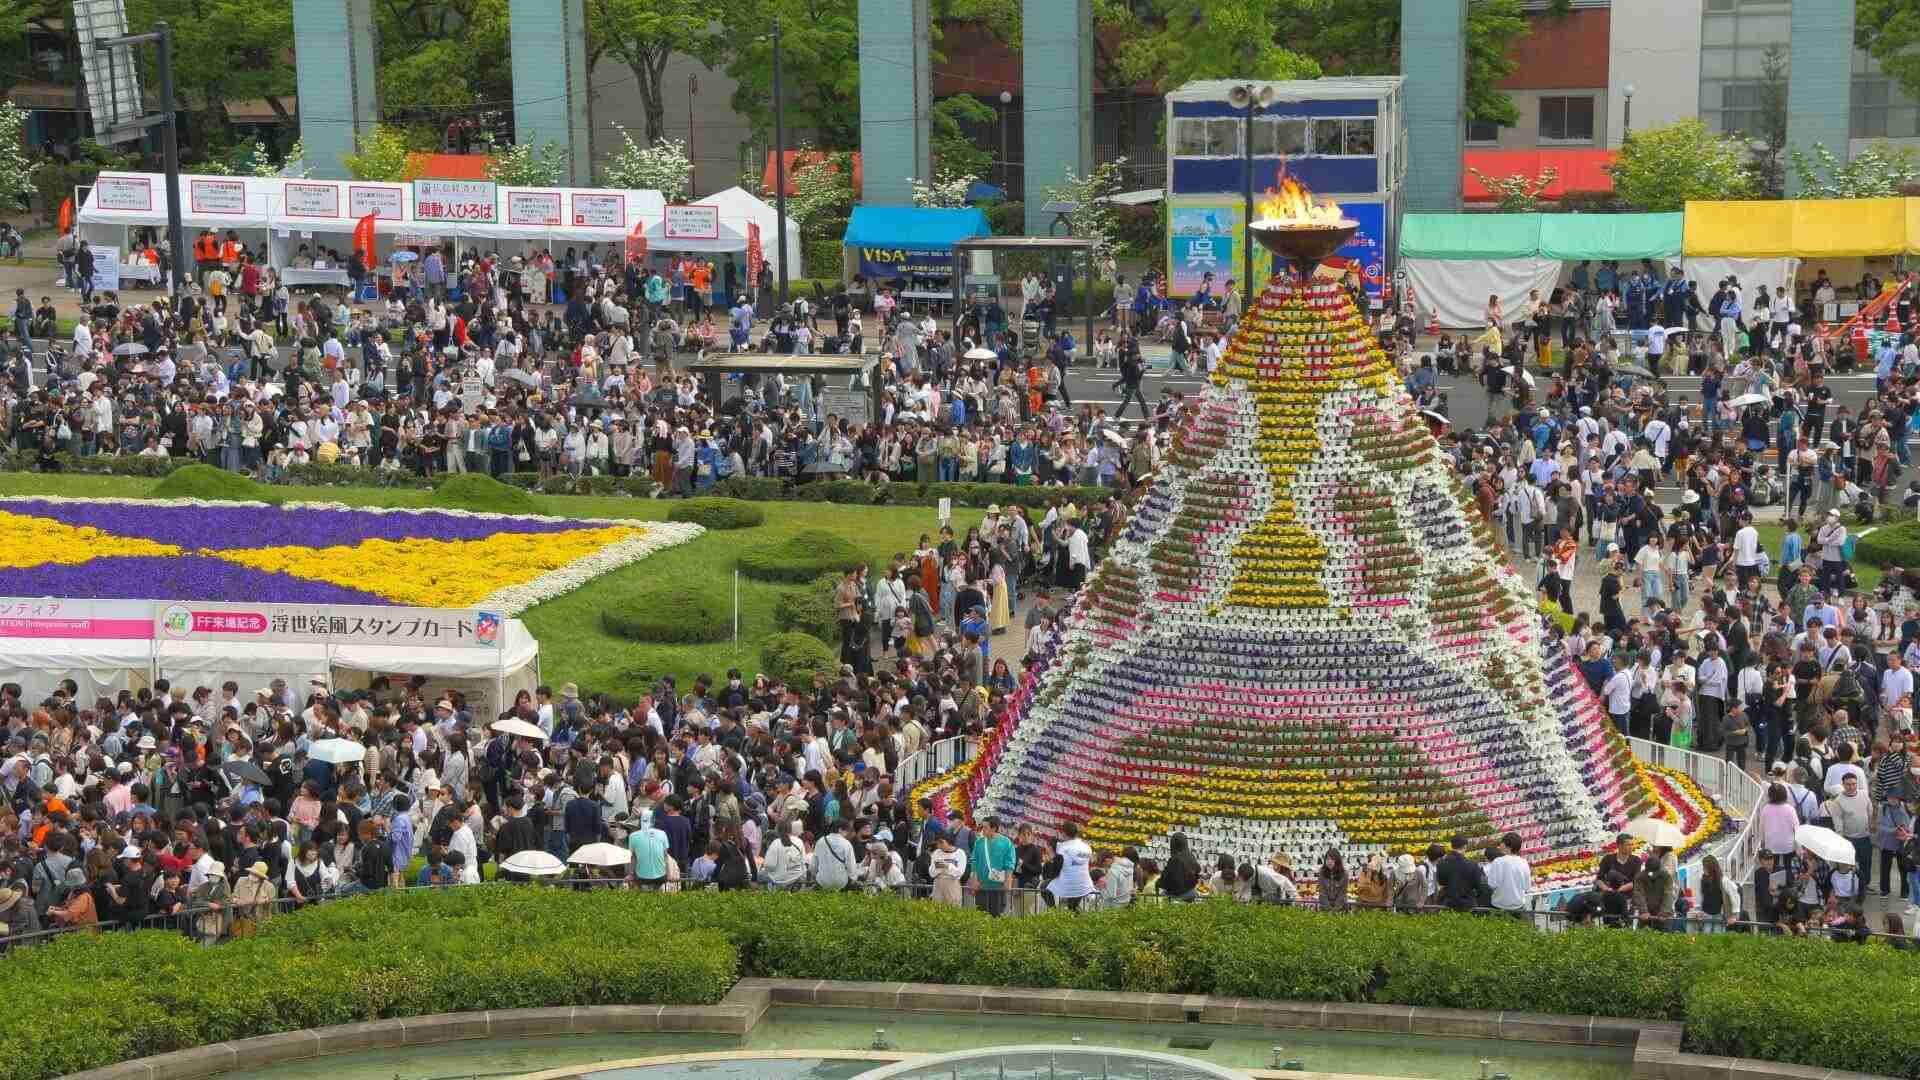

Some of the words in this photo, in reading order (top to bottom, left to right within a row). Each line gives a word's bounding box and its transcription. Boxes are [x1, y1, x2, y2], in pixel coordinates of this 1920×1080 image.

[418, 201, 493, 219] 興動人ひろば
[864, 247, 905, 262] VISA
[1186, 240, 1217, 267] 呉
[196, 615, 261, 630] FF来場記念
[271, 614, 474, 638] 浮世絵風スタンプカード
